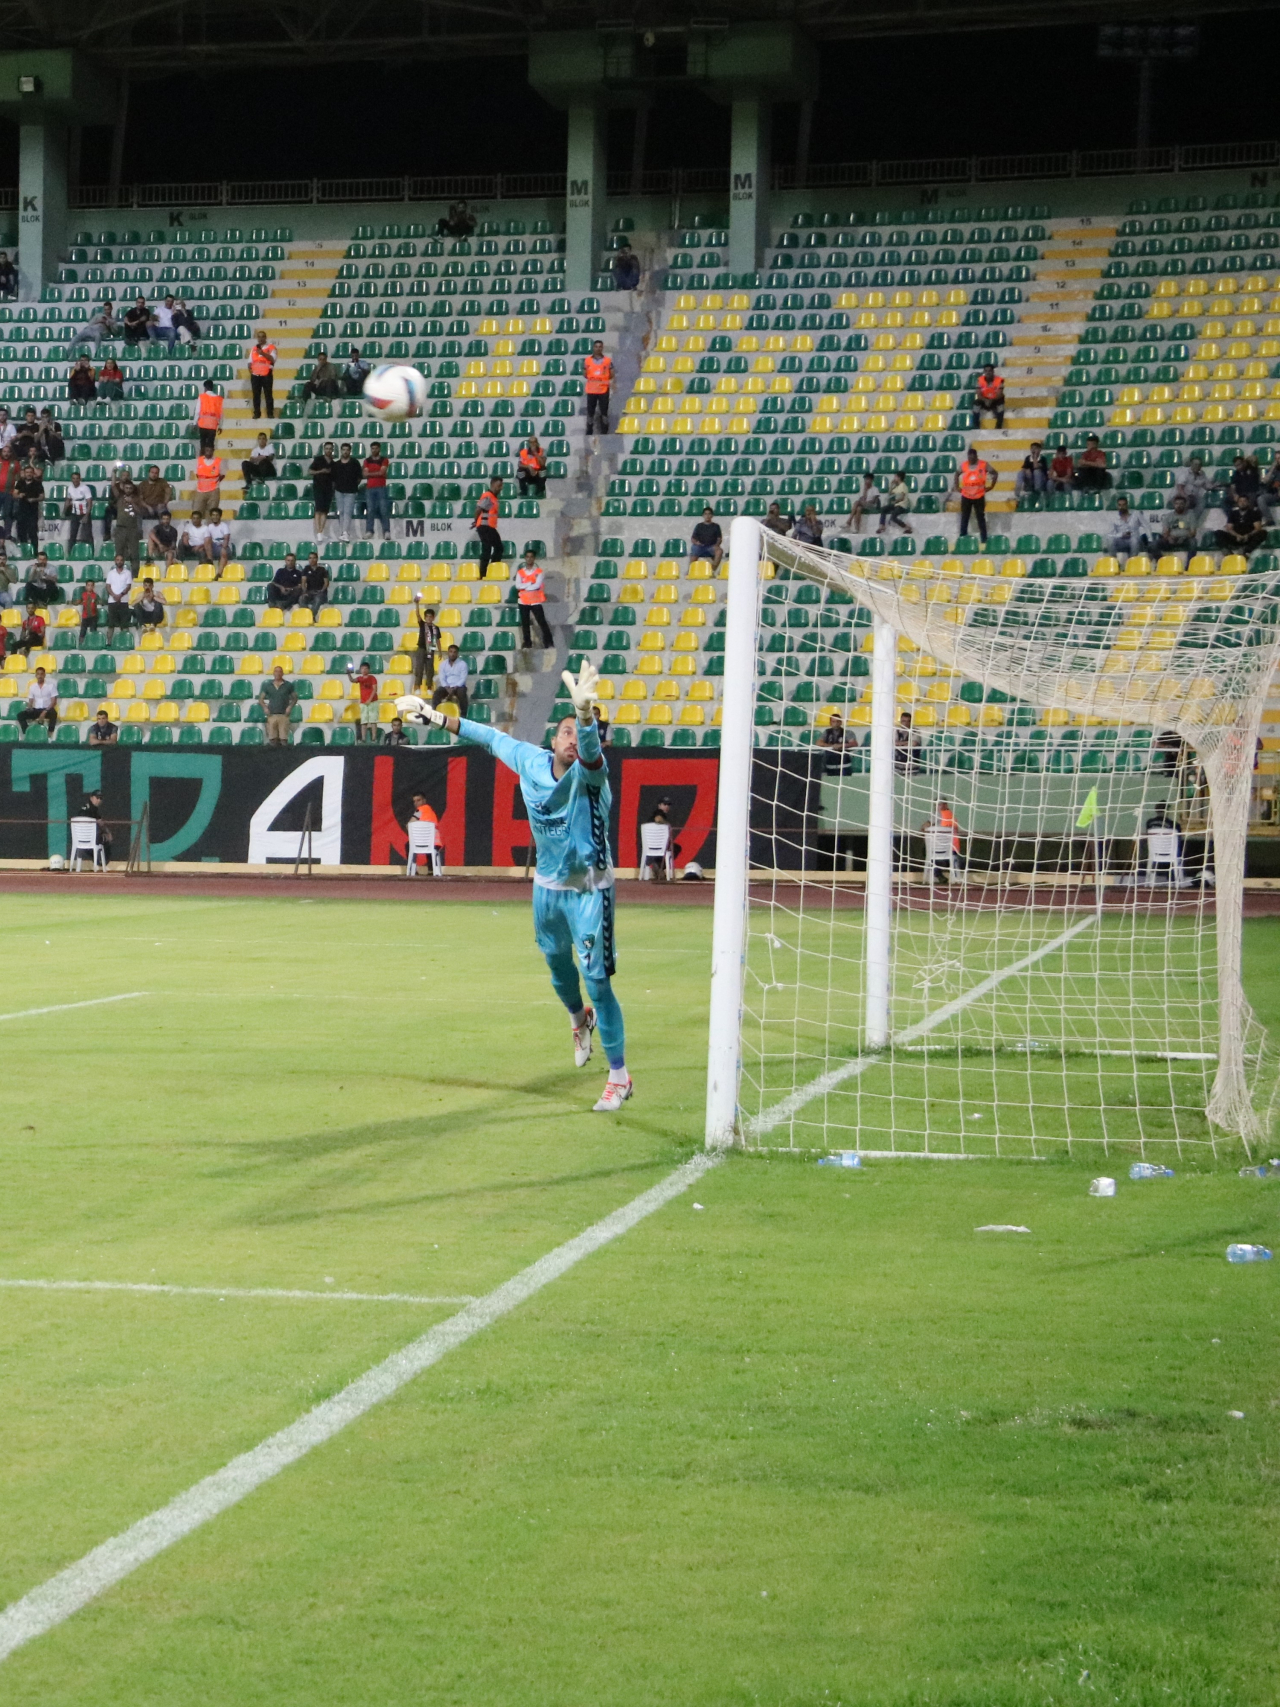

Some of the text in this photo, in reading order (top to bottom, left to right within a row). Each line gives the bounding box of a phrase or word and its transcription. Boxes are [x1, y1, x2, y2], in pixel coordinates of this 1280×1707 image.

[570, 180, 588, 196] M
[734, 173, 752, 190] M
[23, 196, 38, 212] K
[569, 199, 590, 208] BLOK
[732, 191, 753, 201] BLOK
[921, 189, 938, 205] M
[21, 214, 41, 223] BLOK
[169, 211, 184, 227] K
[1056, 281, 1066, 289] 12
[405, 519, 453, 537] M BLOK
